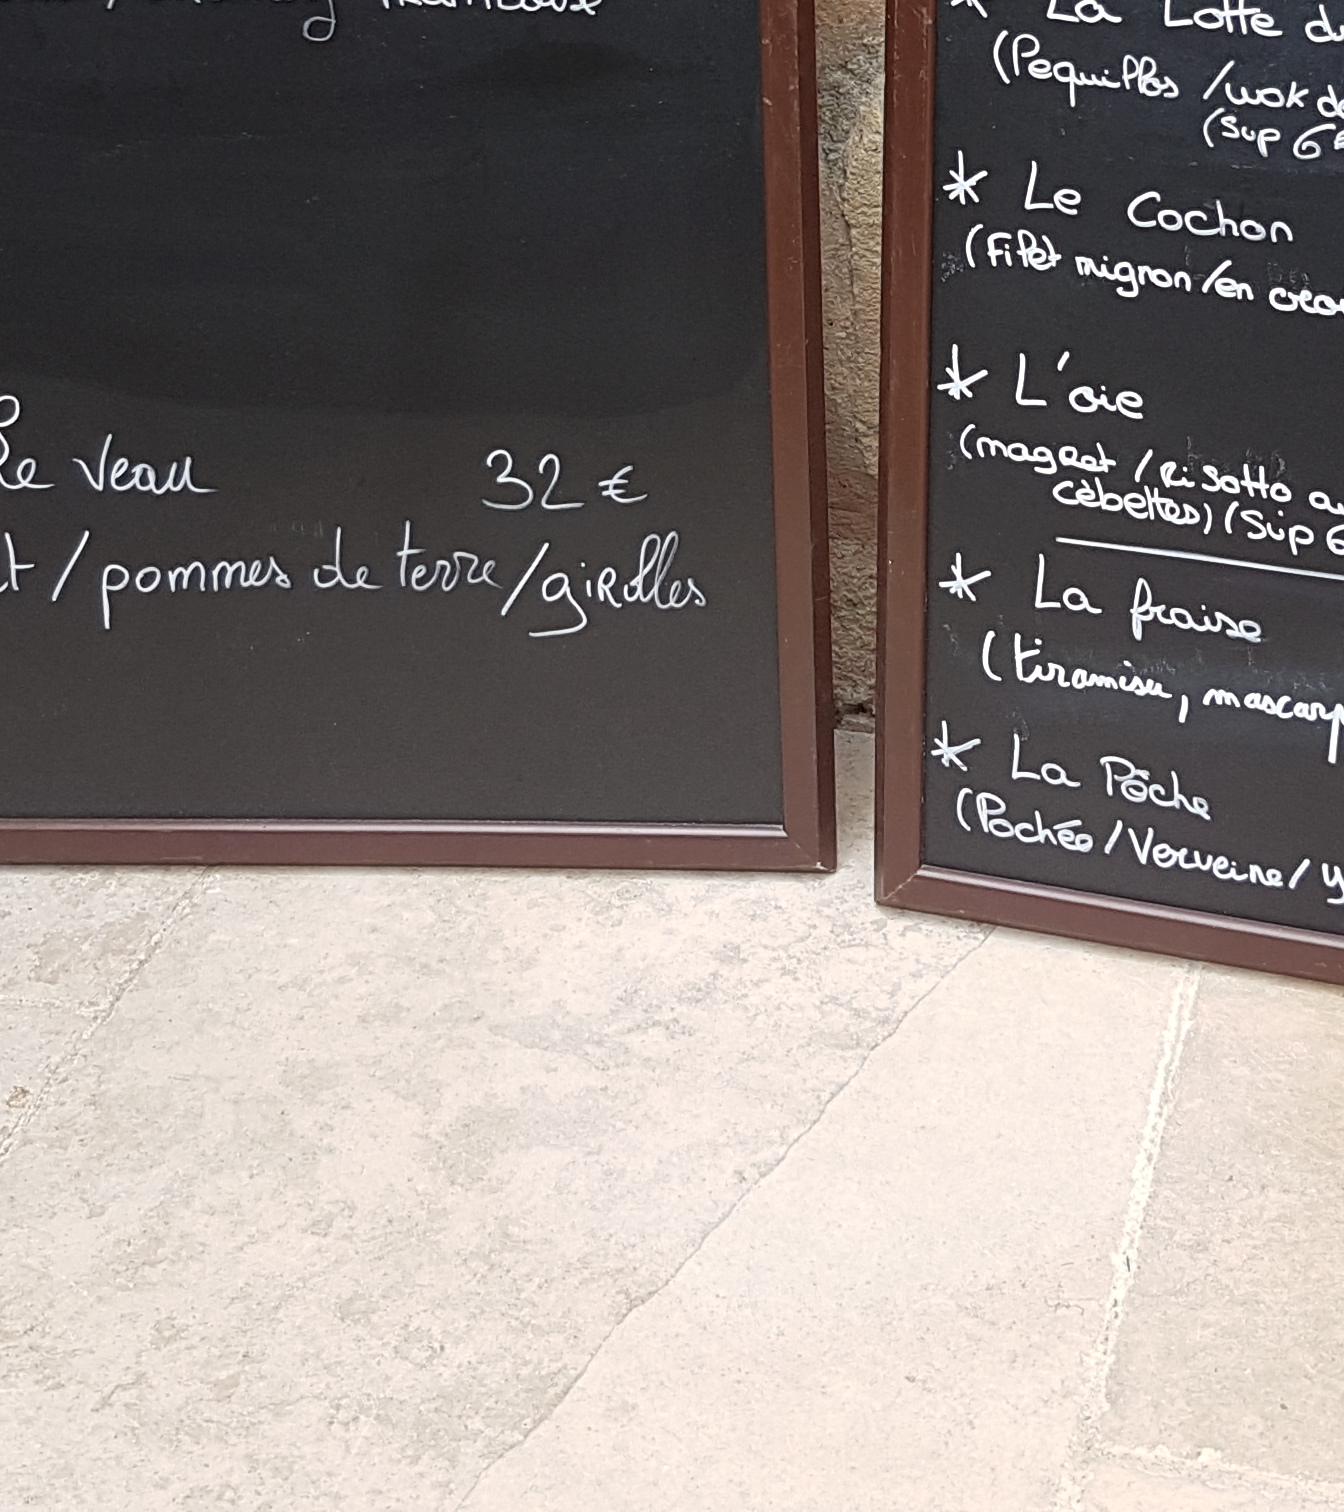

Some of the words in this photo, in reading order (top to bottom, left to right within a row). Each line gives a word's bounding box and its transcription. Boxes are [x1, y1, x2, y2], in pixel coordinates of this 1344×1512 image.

[1023, 160, 1082, 216] Le
[1126, 190, 1294, 243] Cochon
[1074, 255, 1192, 298] mignon
[101, 556, 292, 630] pommes
[312, 526, 383, 590] de
[1034, 553, 1103, 615] La
[1129, 577, 1262, 644] fraise
[1011, 732, 1082, 788] La
